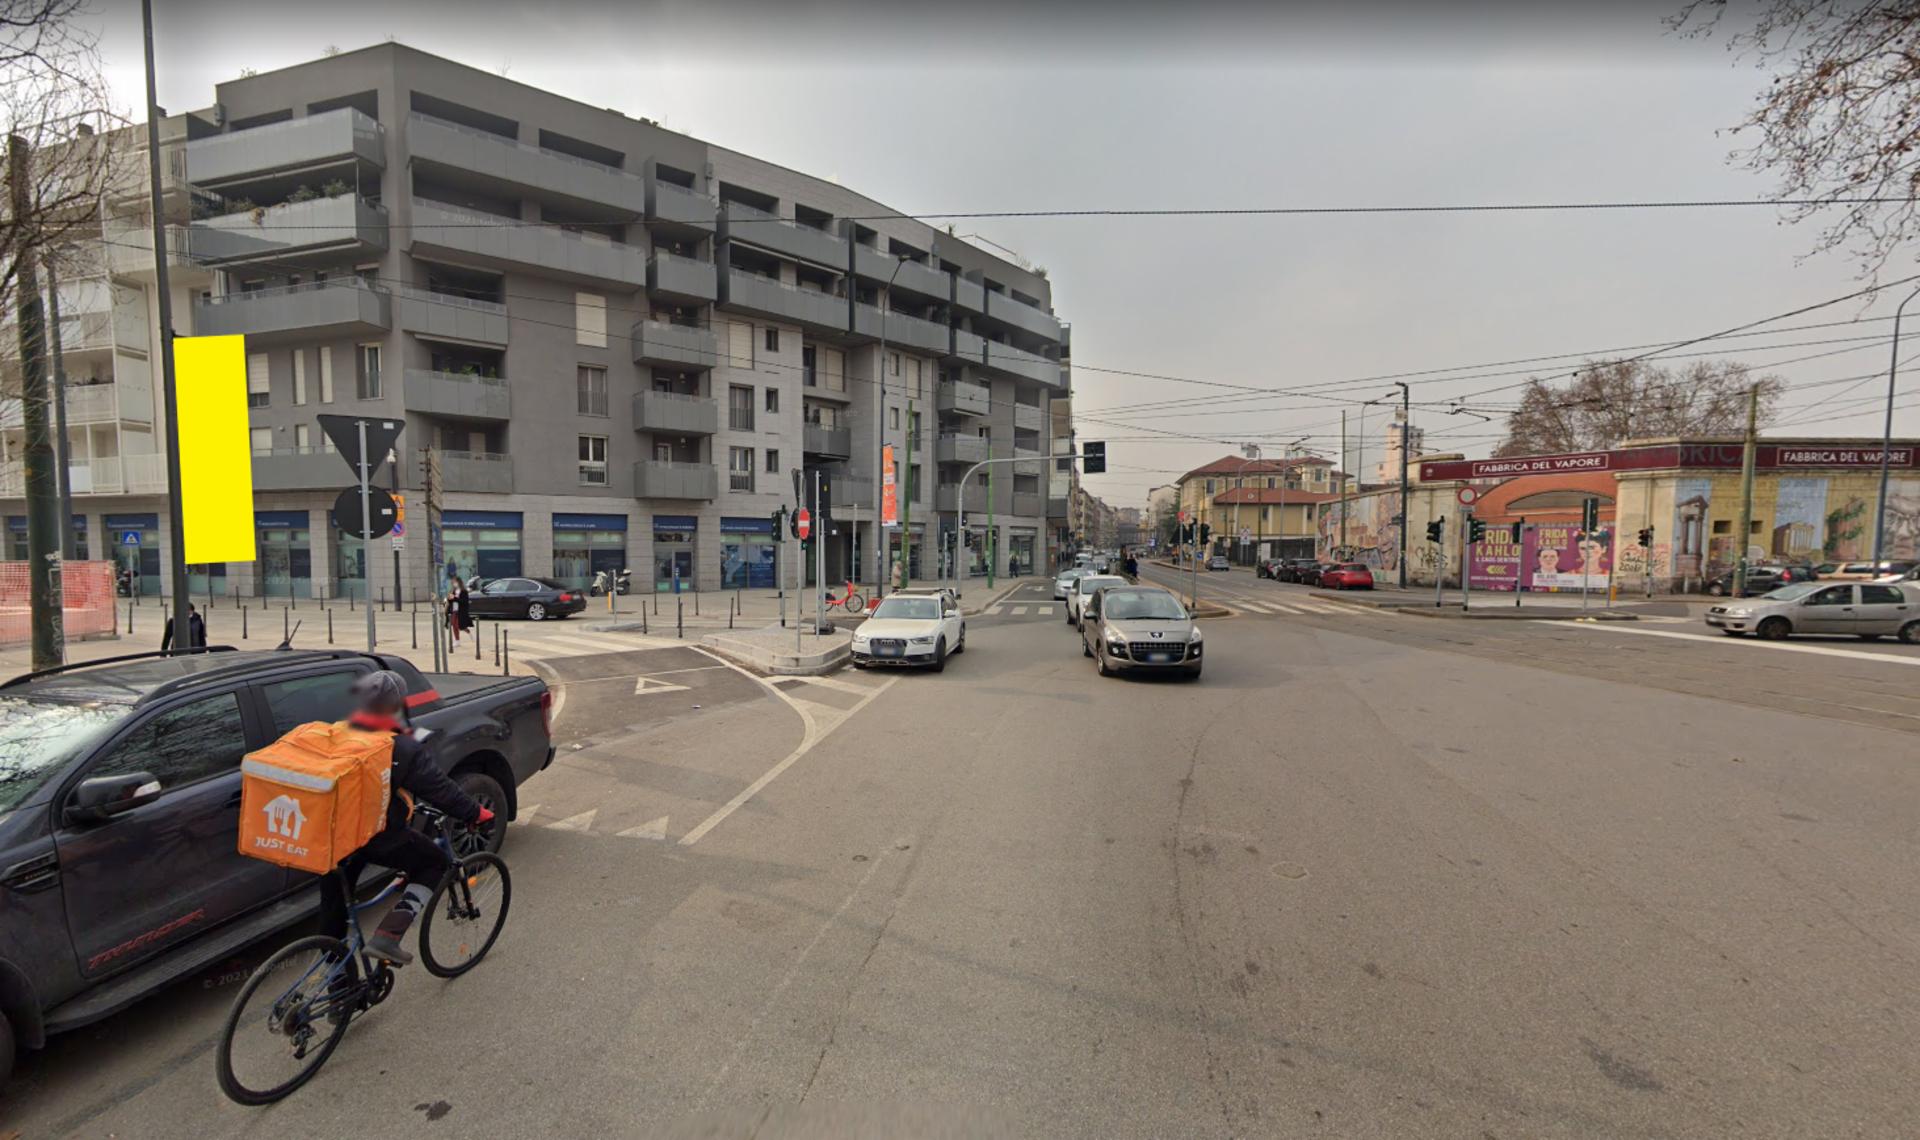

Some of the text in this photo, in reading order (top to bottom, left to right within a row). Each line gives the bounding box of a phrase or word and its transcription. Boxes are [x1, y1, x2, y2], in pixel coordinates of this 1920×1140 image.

[1783, 452, 1837, 462] FABBRICA
[1839, 452, 1859, 462] DEL
[1479, 457, 1602, 473] FABBRICA DEL VAPORE
[1539, 528, 1568, 538] FRIDA
[1476, 544, 1520, 557] KAHLO
[255, 836, 309, 856] JUST EAT
